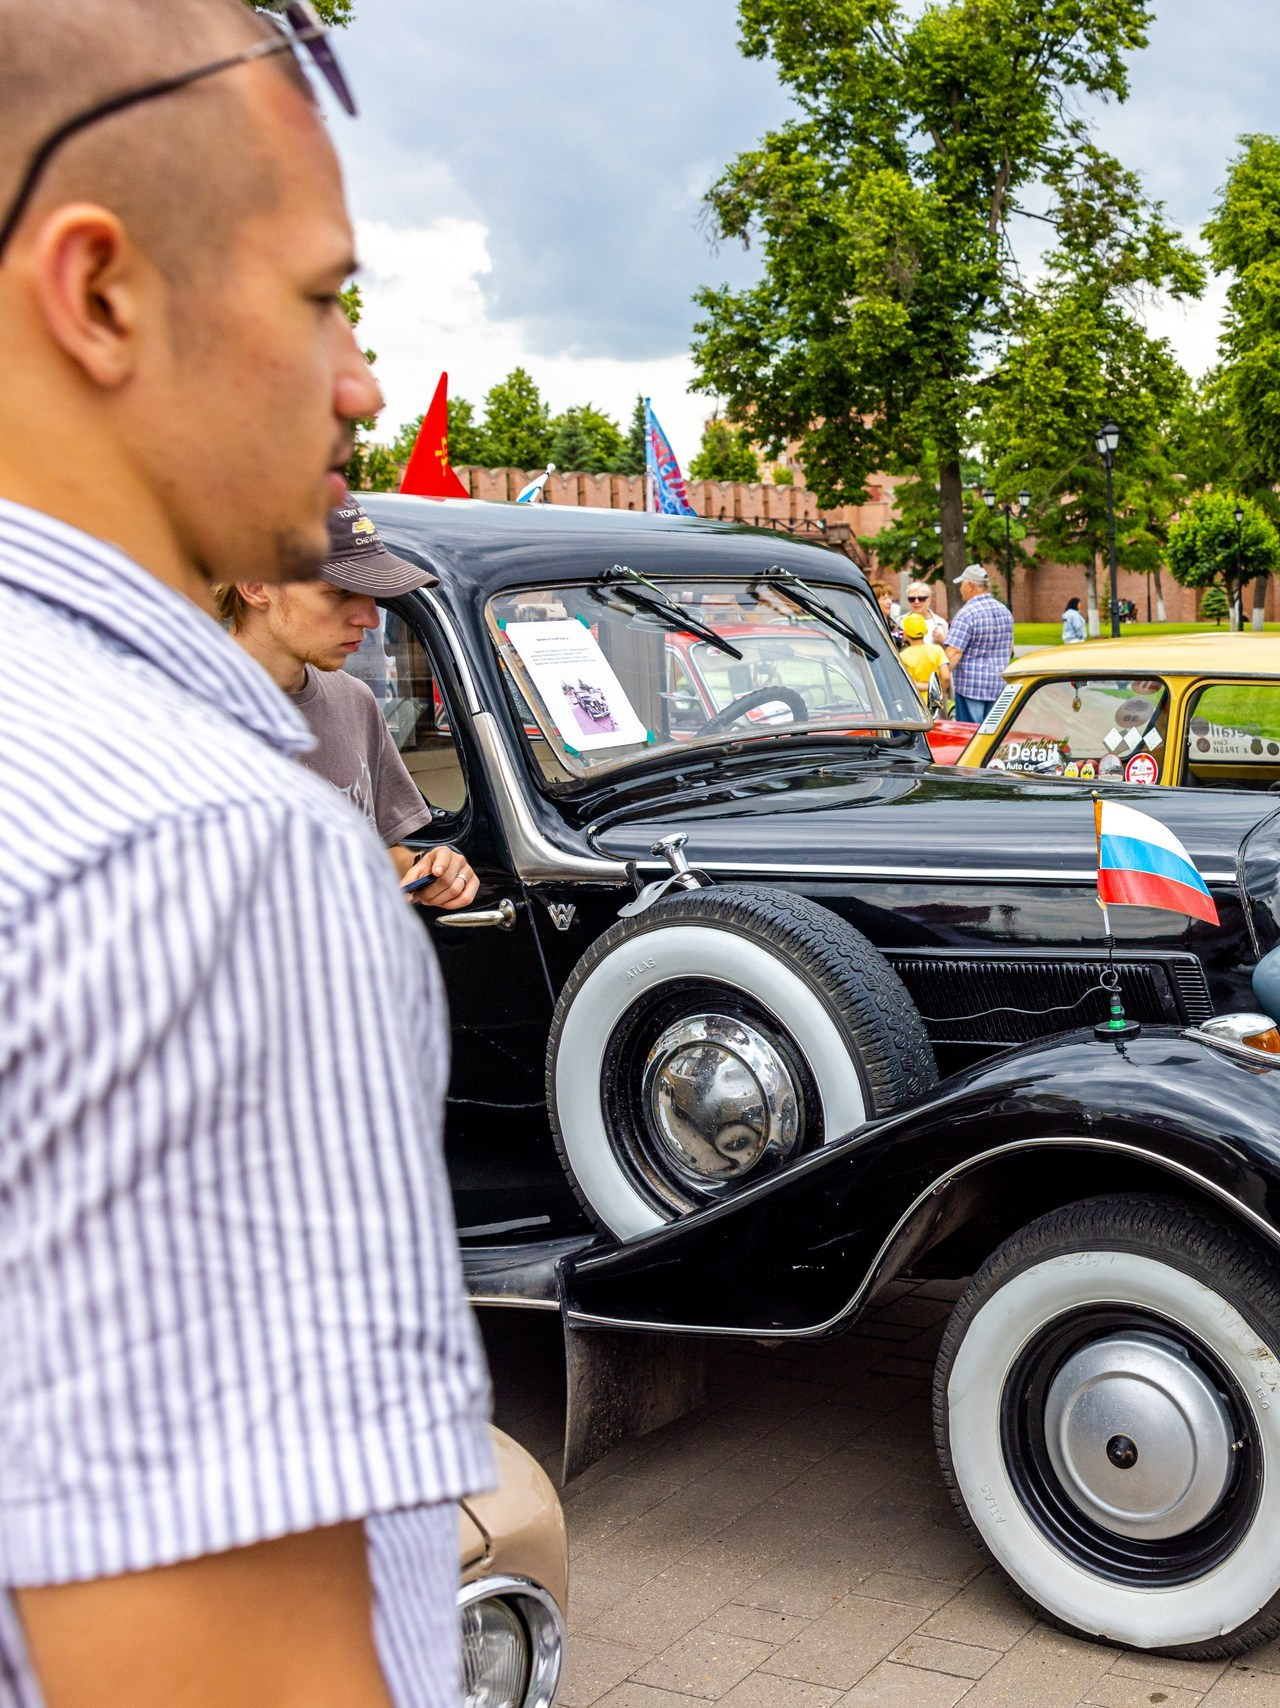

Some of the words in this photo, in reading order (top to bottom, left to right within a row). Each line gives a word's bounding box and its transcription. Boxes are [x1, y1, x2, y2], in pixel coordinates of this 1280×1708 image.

[338, 508, 358, 518] TONY
[1008, 743, 1058, 762] Detail
[1006, 762, 1023, 770] Auto
[1023, 762, 1036, 771] Car
[626, 958, 656, 982] ATLAS
[980, 1484, 1007, 1523] ATLAS
